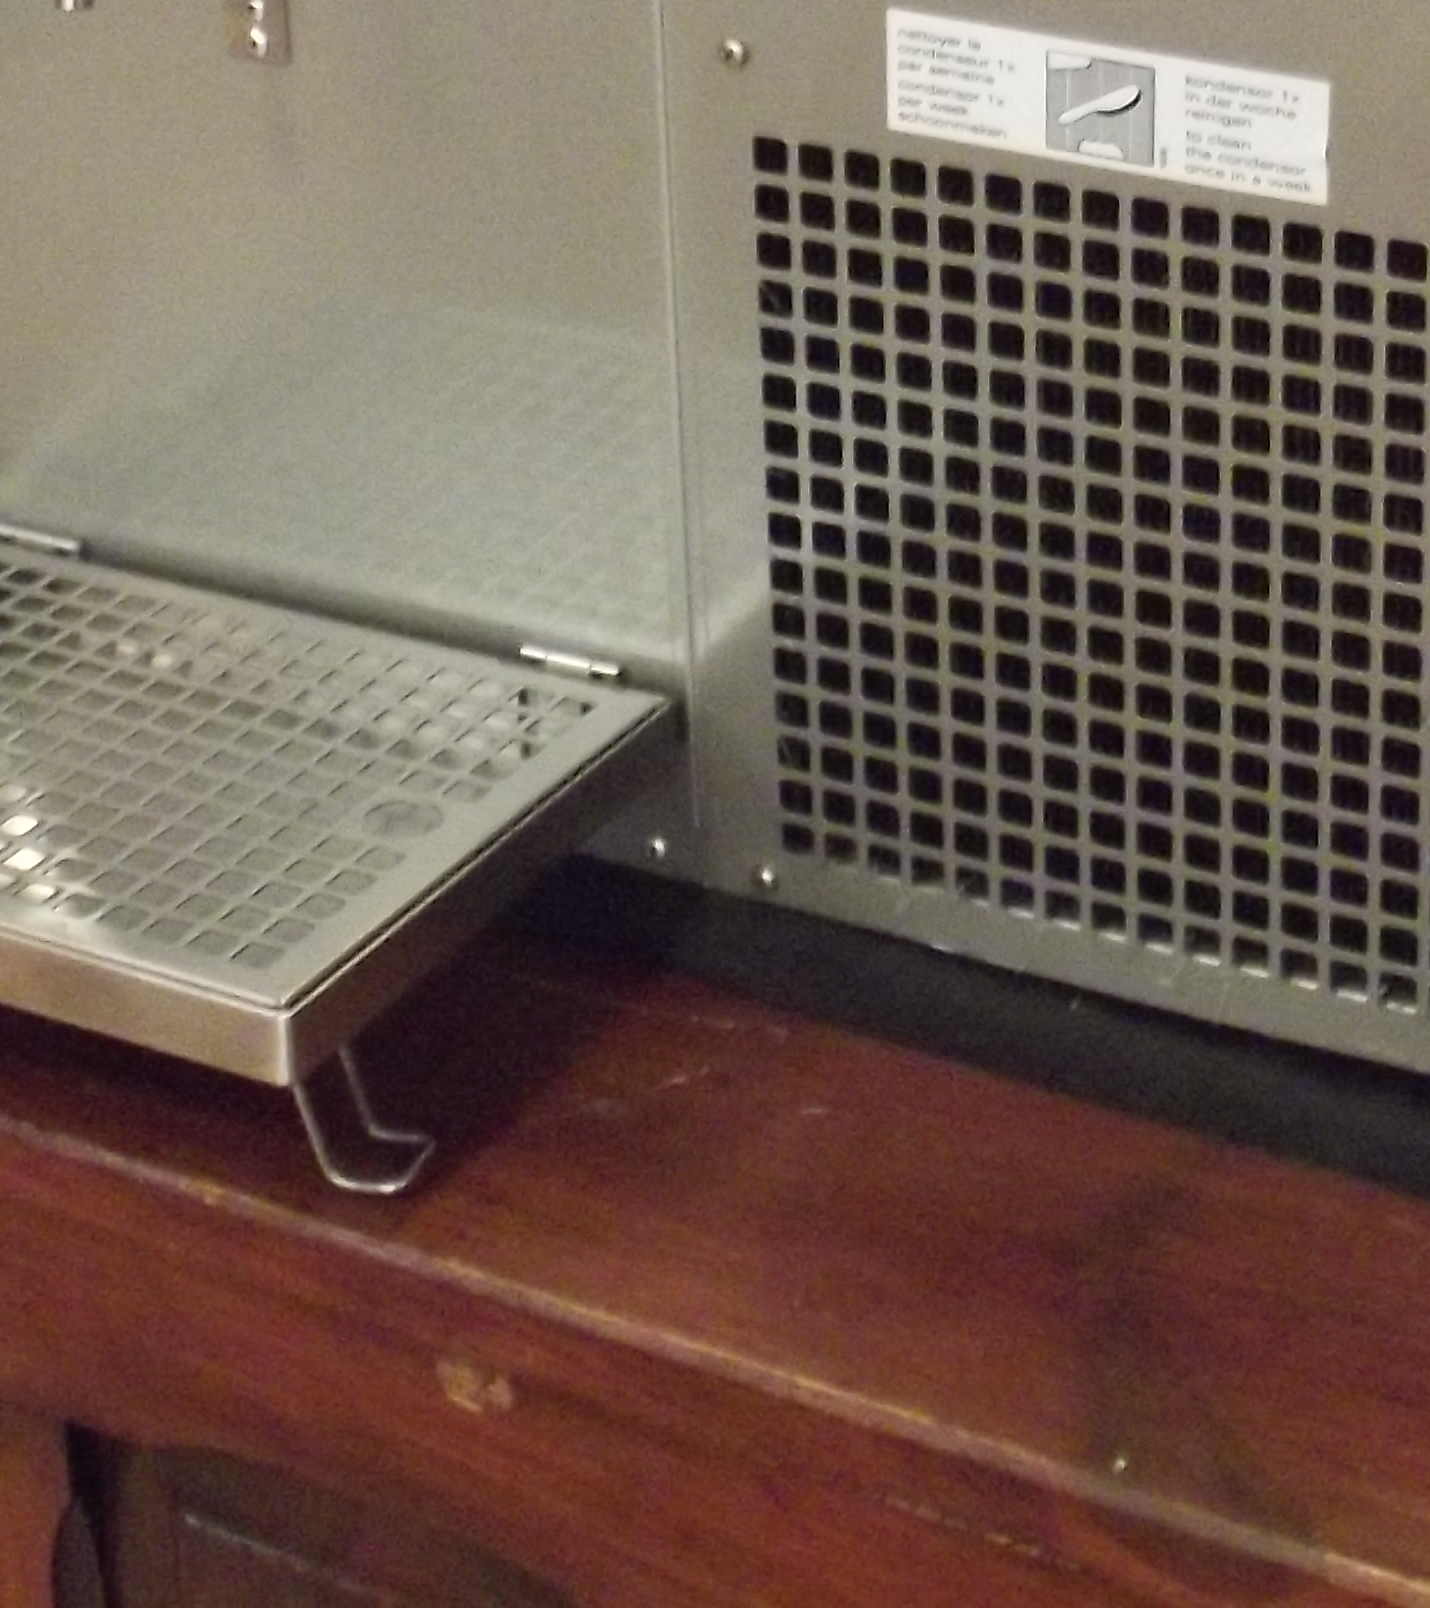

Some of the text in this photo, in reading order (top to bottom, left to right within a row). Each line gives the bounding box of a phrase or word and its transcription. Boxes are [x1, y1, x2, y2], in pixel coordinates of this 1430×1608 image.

[898, 28, 962, 48] nettoyer
[897, 44, 989, 69] condenseur
[929, 65, 996, 86] semaine
[1184, 73, 1299, 104] kondensor 1x
[1206, 94, 1232, 110] der
[1185, 130, 1252, 151] to clean
[1185, 146, 1212, 162] the
